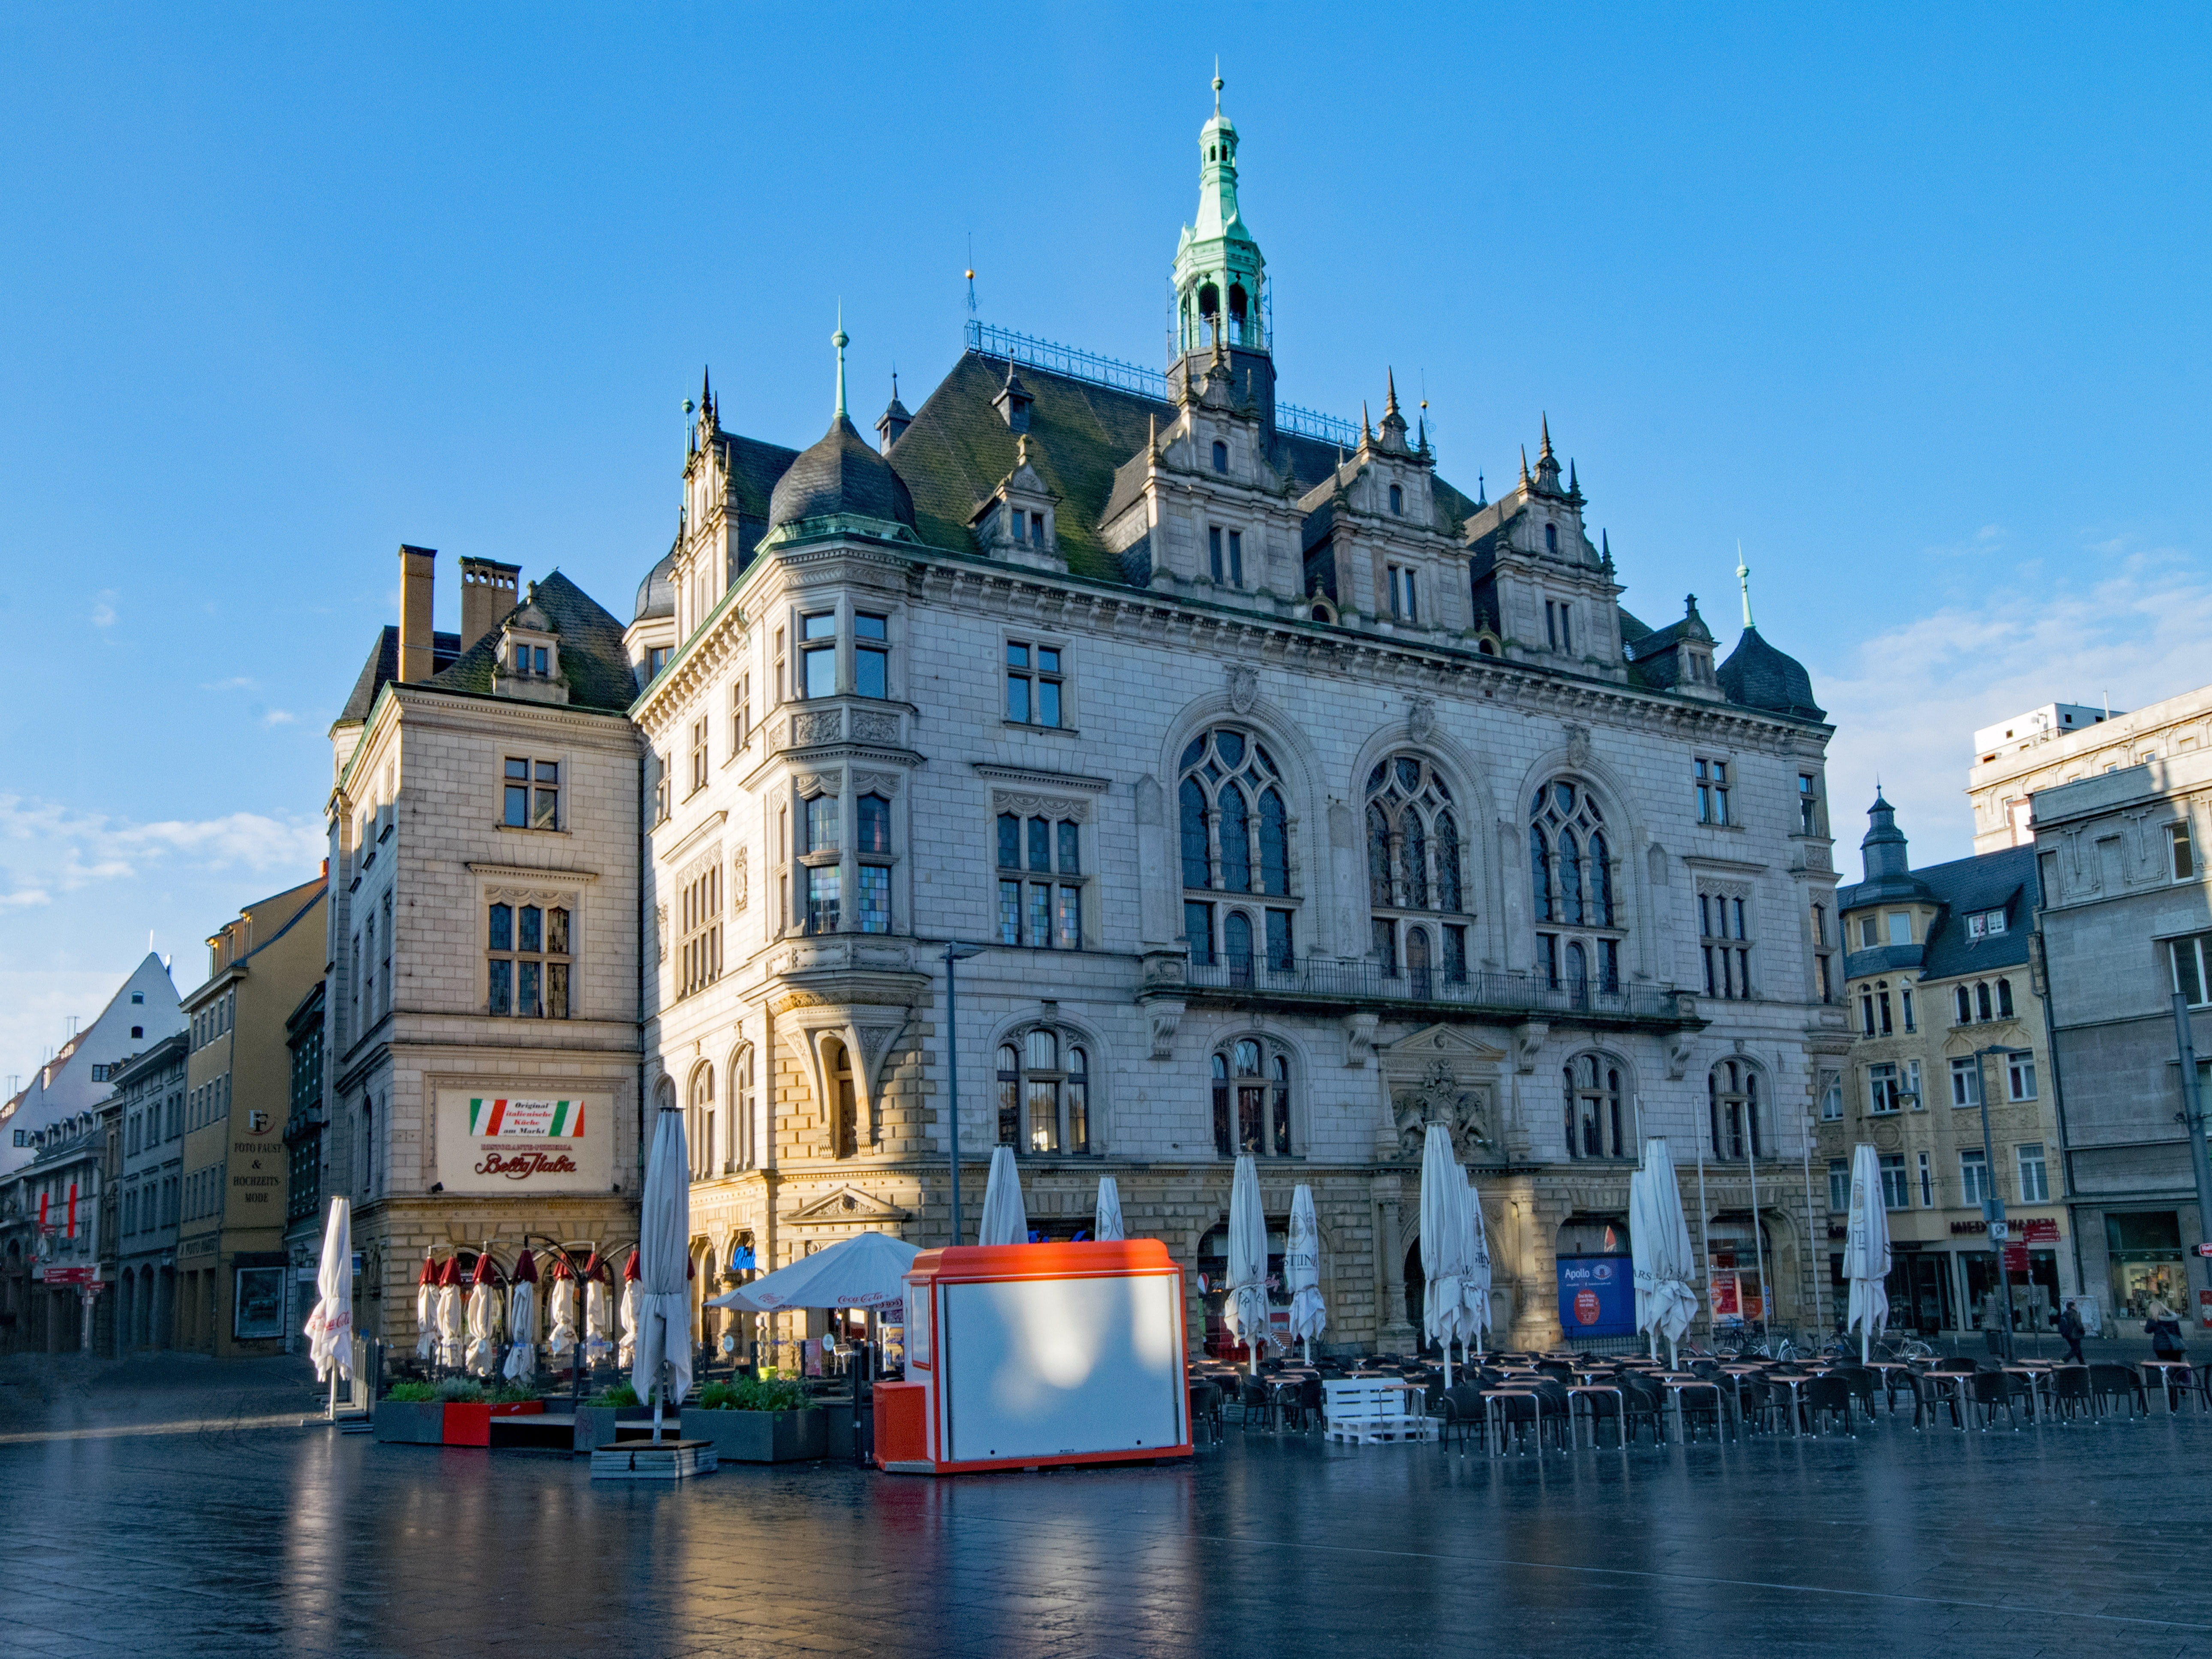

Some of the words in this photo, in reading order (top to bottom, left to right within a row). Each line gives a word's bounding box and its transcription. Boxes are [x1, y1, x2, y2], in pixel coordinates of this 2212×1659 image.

[235, 1143, 256, 1153] FOTO
[257, 1143, 282, 1153] FAUST
[252, 1159, 261, 1169] &
[475, 1153, 531, 1174] Bella
[245, 1192, 269, 1203] MODE
[1565, 1268, 1590, 1280] Apollo
